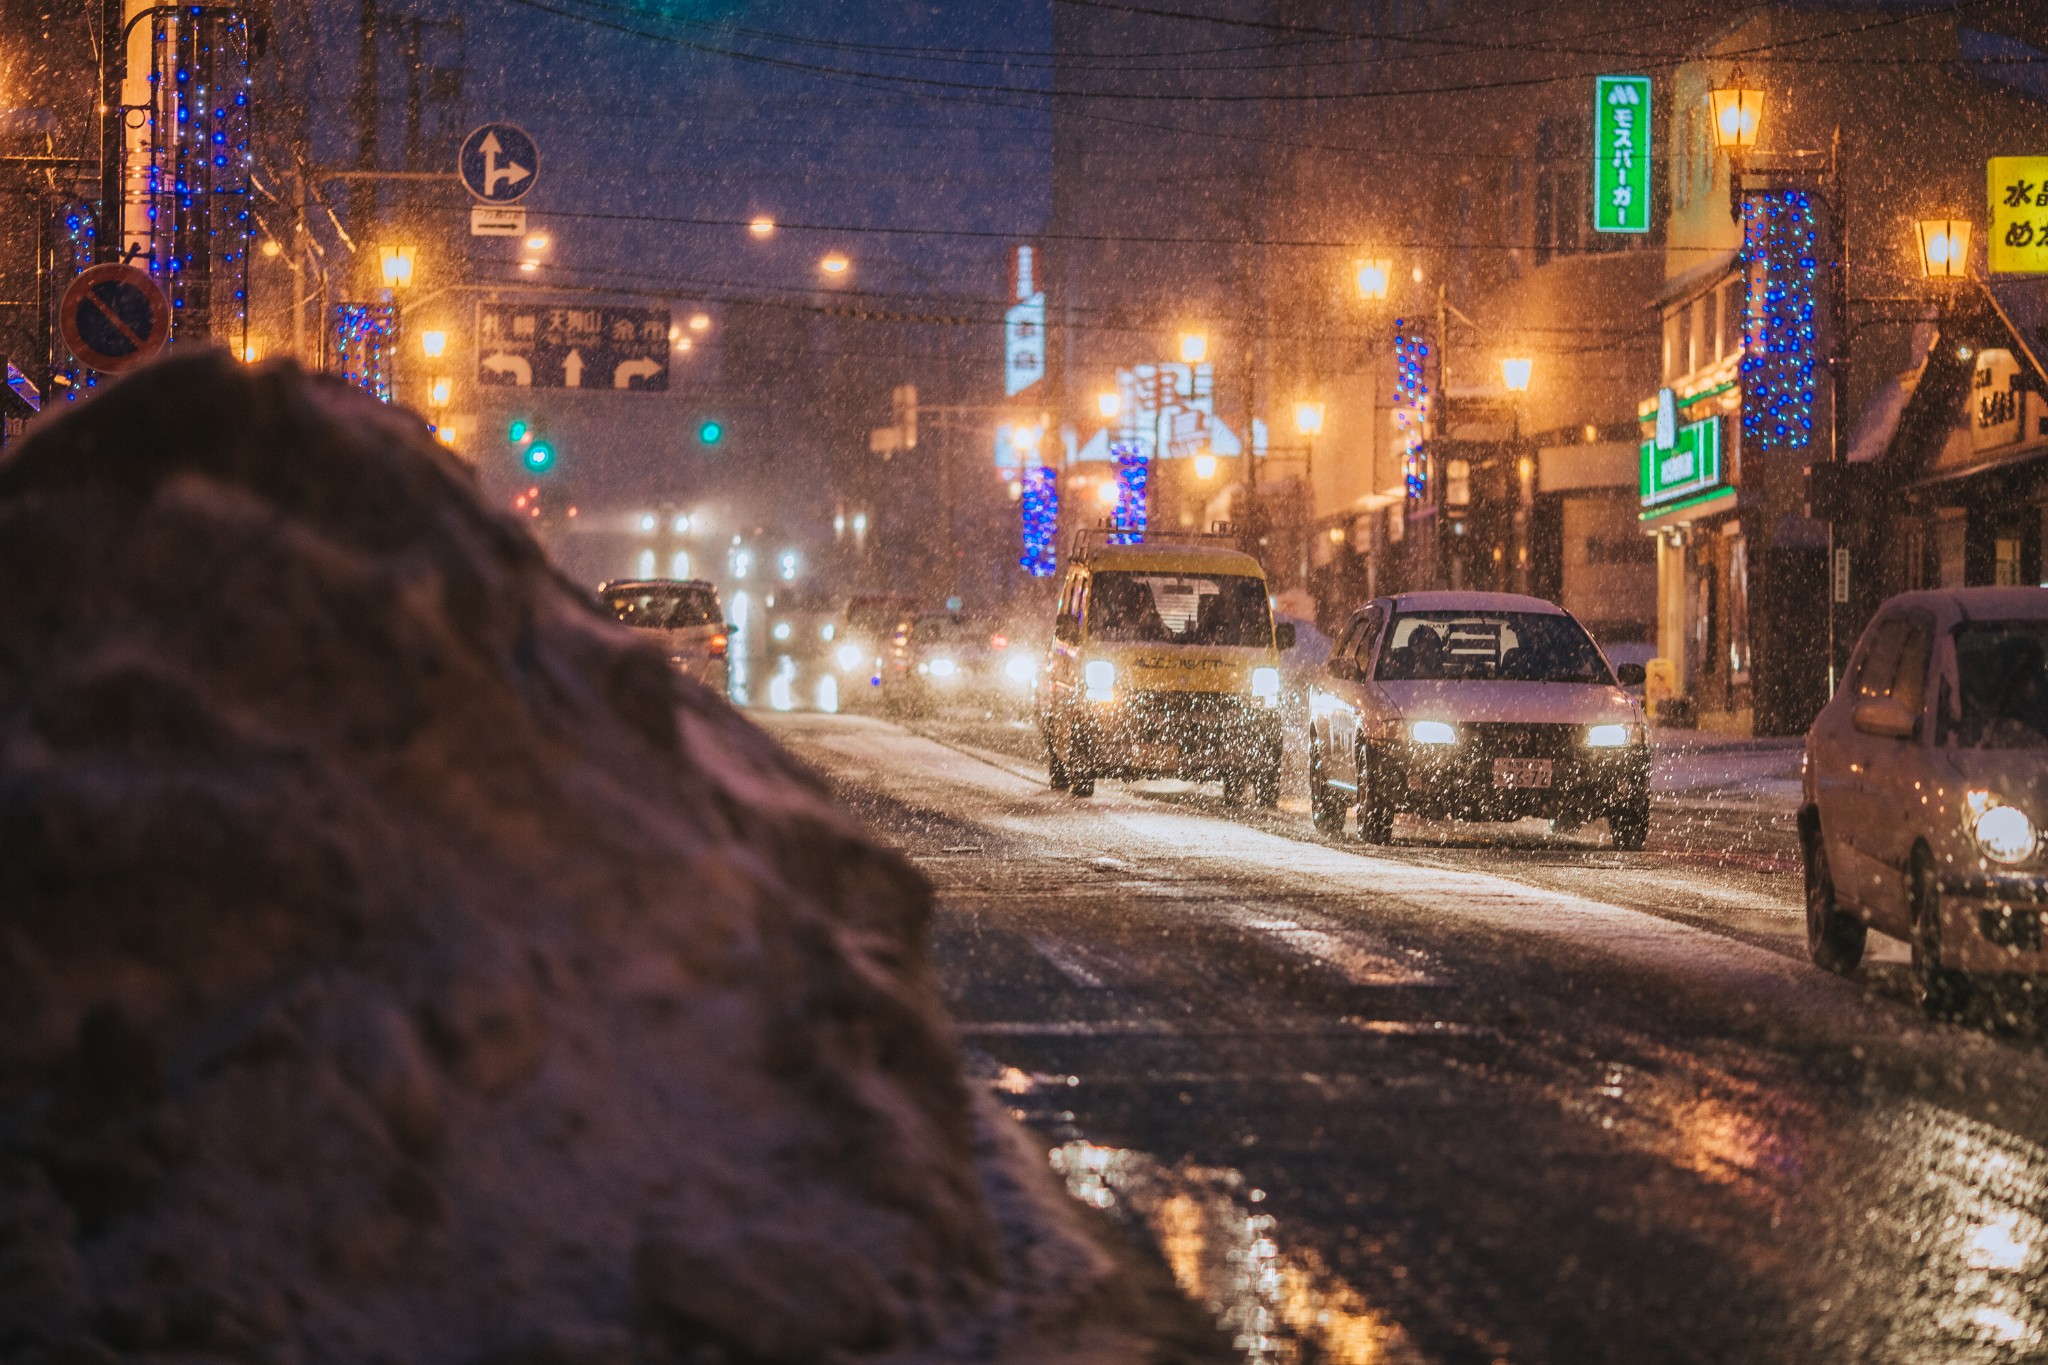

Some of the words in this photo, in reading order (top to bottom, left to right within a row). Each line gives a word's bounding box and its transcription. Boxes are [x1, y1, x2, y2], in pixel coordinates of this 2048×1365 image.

[1613, 108, 1634, 226] モスバーガー
